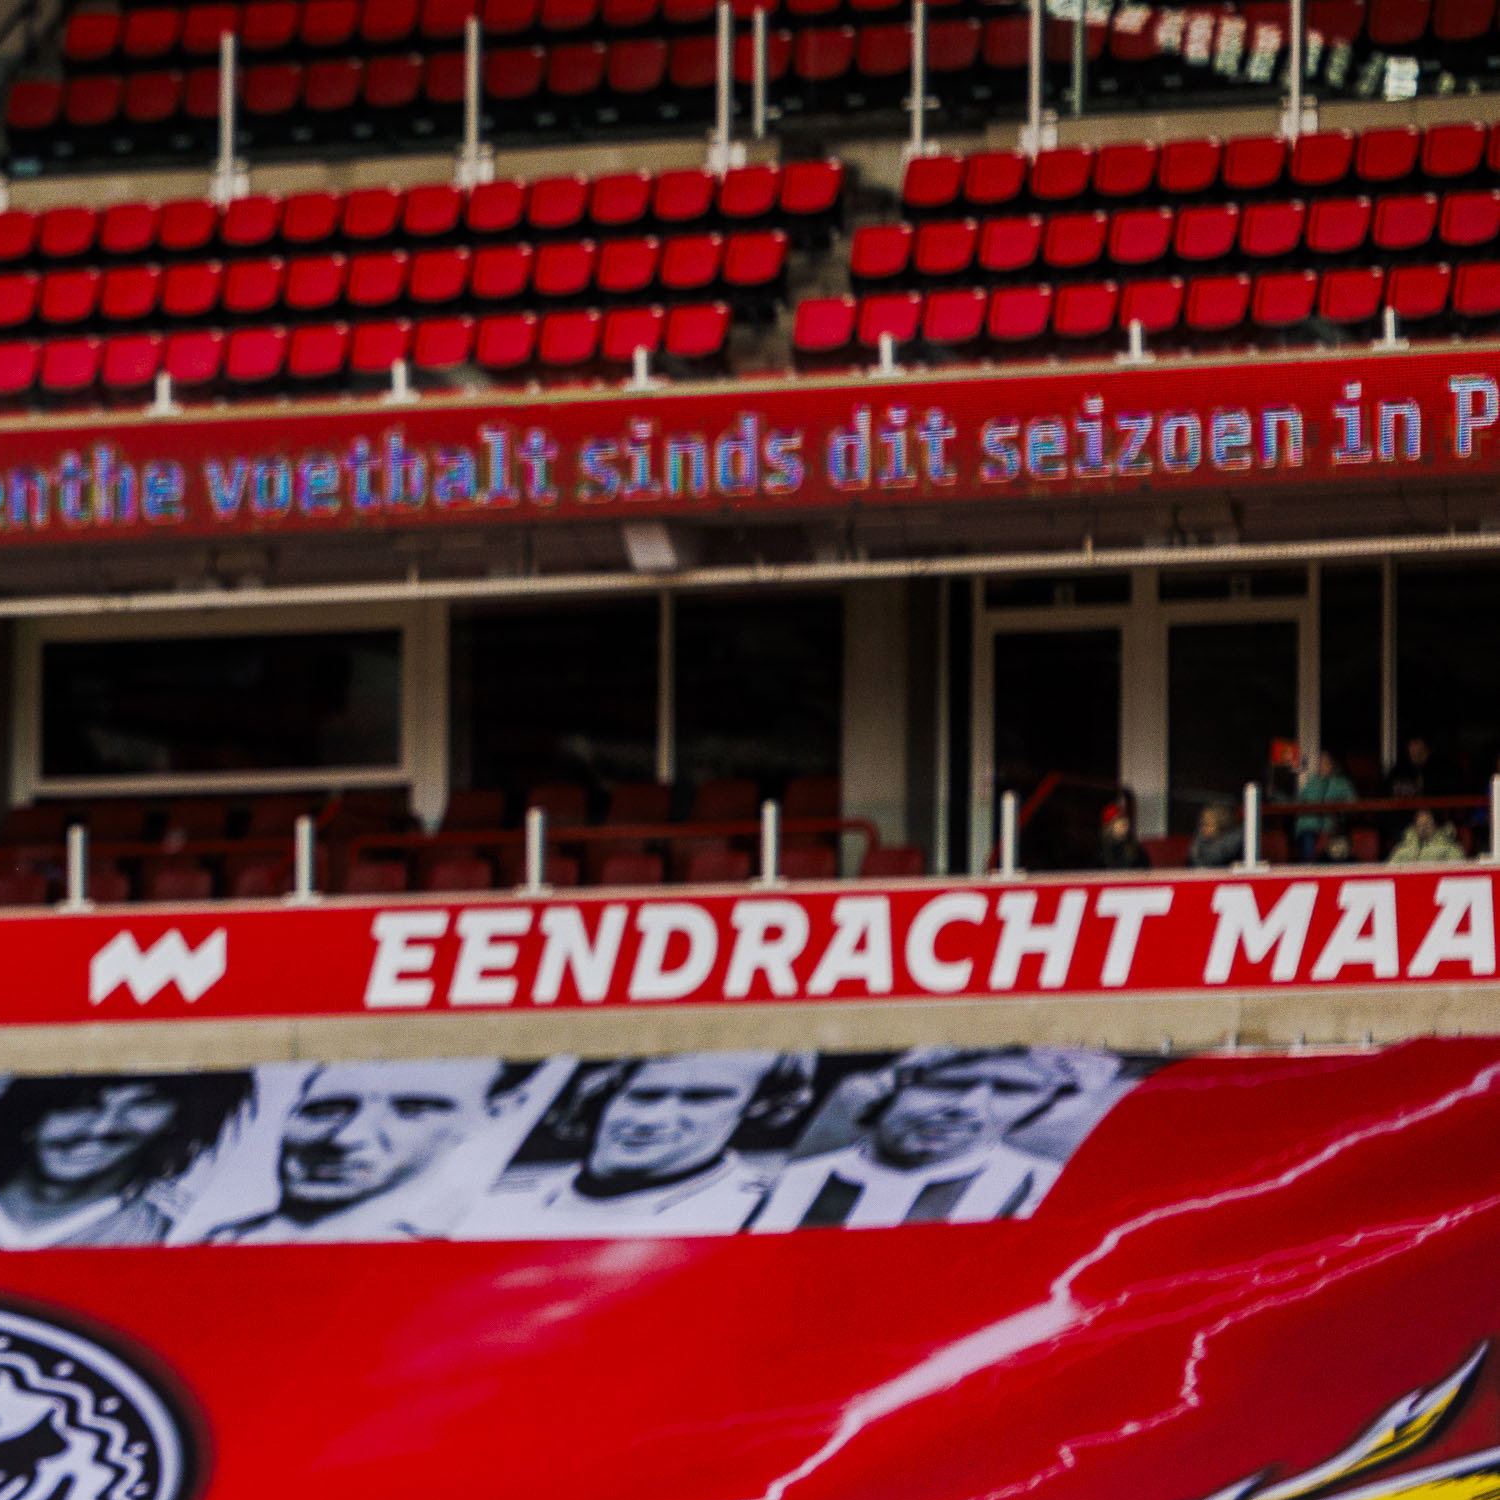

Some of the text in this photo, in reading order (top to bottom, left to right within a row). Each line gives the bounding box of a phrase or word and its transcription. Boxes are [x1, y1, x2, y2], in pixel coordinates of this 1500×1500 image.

[577, 413, 804, 503] sinds
[828, 402, 957, 491] dit
[980, 395, 1303, 484] seizoen
[1333, 380, 1421, 466] in
[1449, 373, 1500, 458] P
[364, 884, 1173, 1007] EENDRACHT
